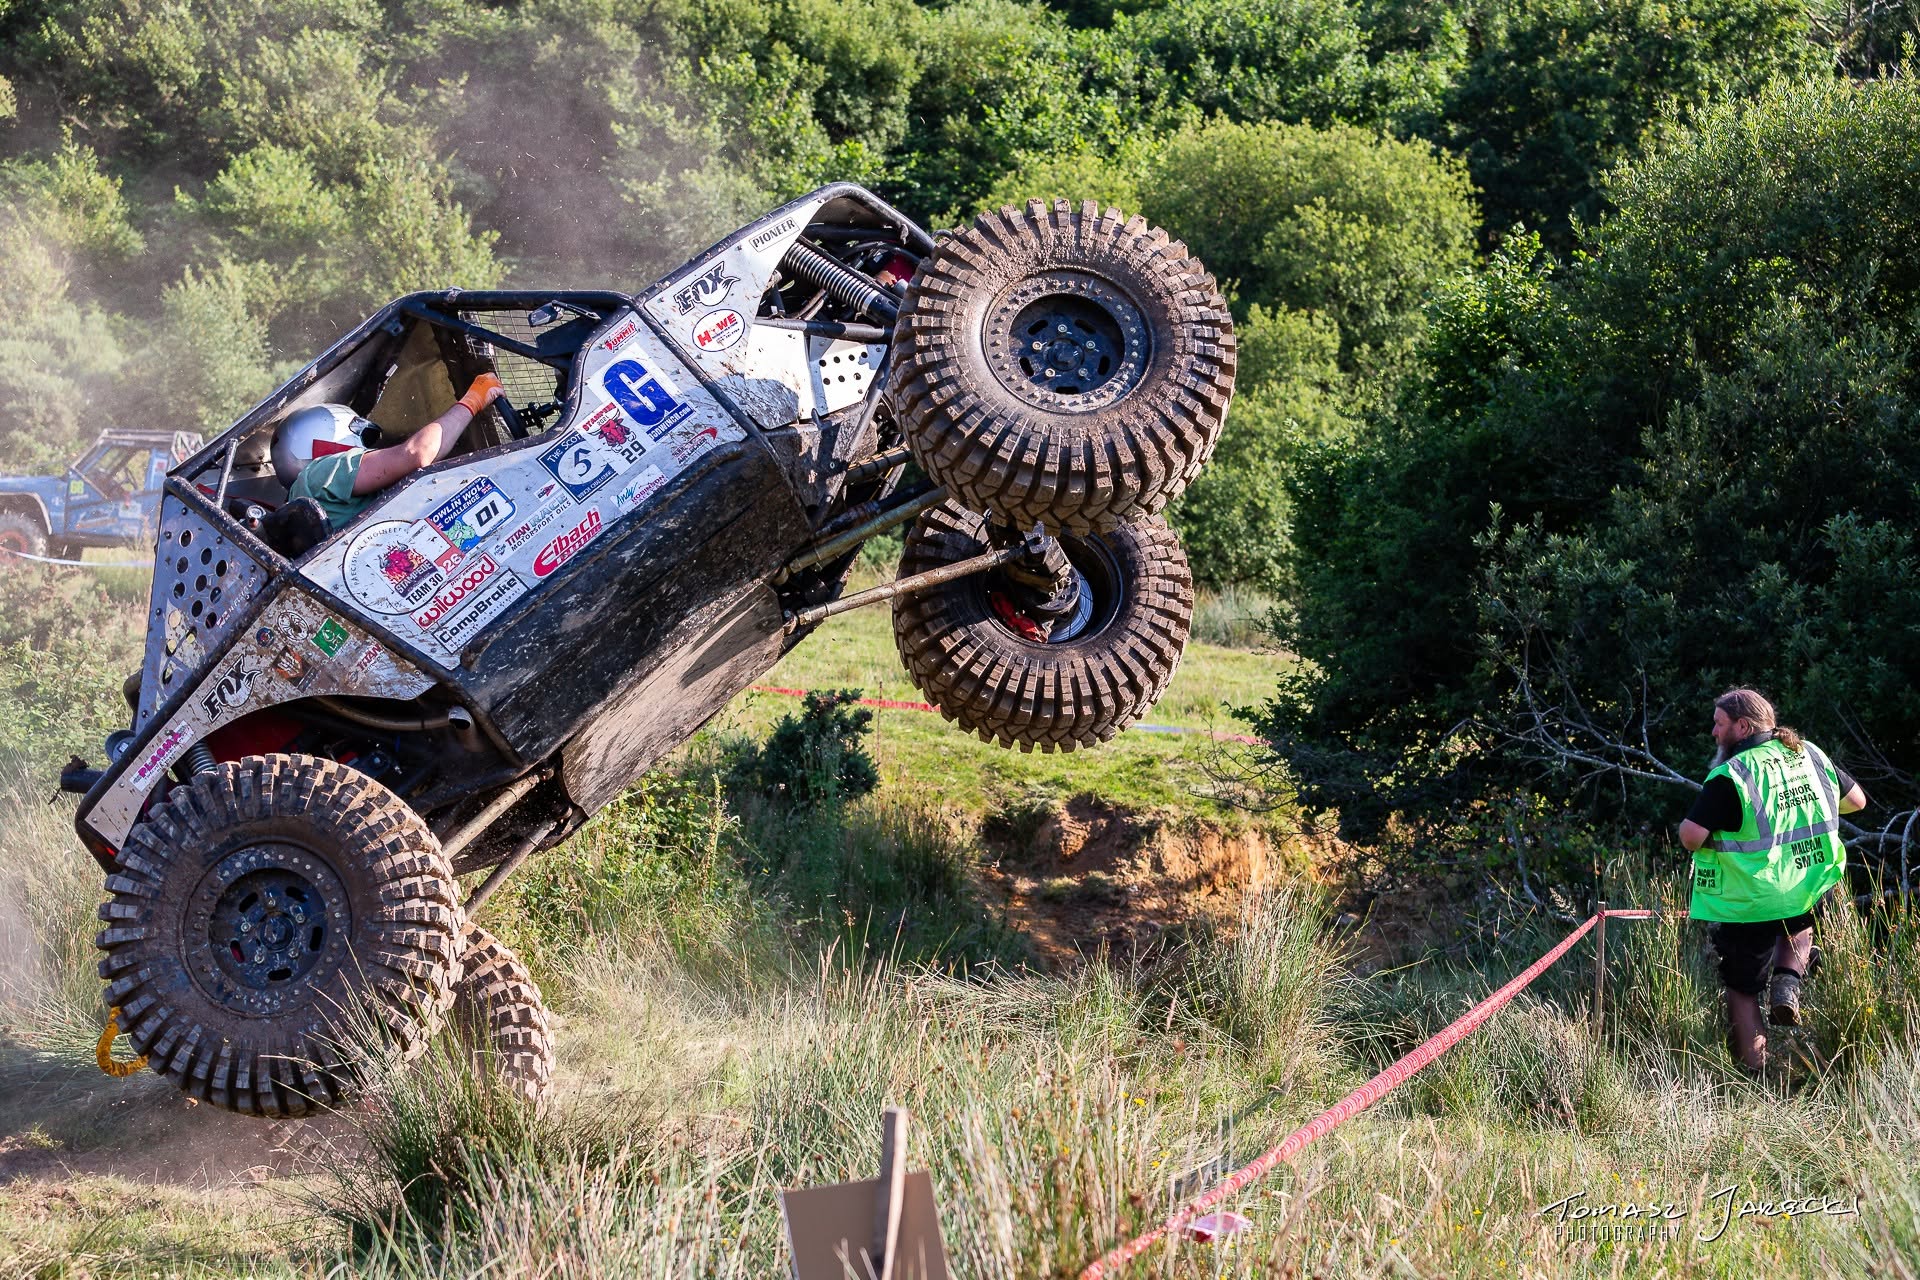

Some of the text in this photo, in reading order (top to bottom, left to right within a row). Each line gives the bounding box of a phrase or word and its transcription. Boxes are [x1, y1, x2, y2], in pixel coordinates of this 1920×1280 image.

[752, 219, 796, 248] PIONEER
[674, 262, 725, 315] FOX
[604, 360, 678, 425] G
[547, 448, 562, 462] THE
[621, 439, 646, 464] 29
[430, 497, 462, 522] OWLIN
[461, 478, 485, 500] WOLF
[631, 474, 664, 502] ROBINSON
[443, 493, 480, 523] CHALLENGE
[505, 523, 531, 547] TITAN
[530, 492, 568, 529] RACE
[511, 514, 555, 551] MOTORSPORT
[555, 501, 572, 515] OILS
[534, 509, 601, 577] Eibach
[405, 582, 431, 604] TEAM
[429, 572, 443, 587] 30
[418, 555, 495, 627] wilwood
[439, 577, 517, 643] CompBrake
[356, 643, 382, 670] TITAN
[201, 654, 249, 722] FOX
[139, 733, 182, 777] PLASMA
[1777, 793, 1820, 812] MARSHAL
[1779, 783, 1812, 801] SENIOR
[1791, 836, 1823, 856] MALCOLM
[1795, 851, 1825, 870] SM 13
[1696, 876, 1715, 888] SM 13
